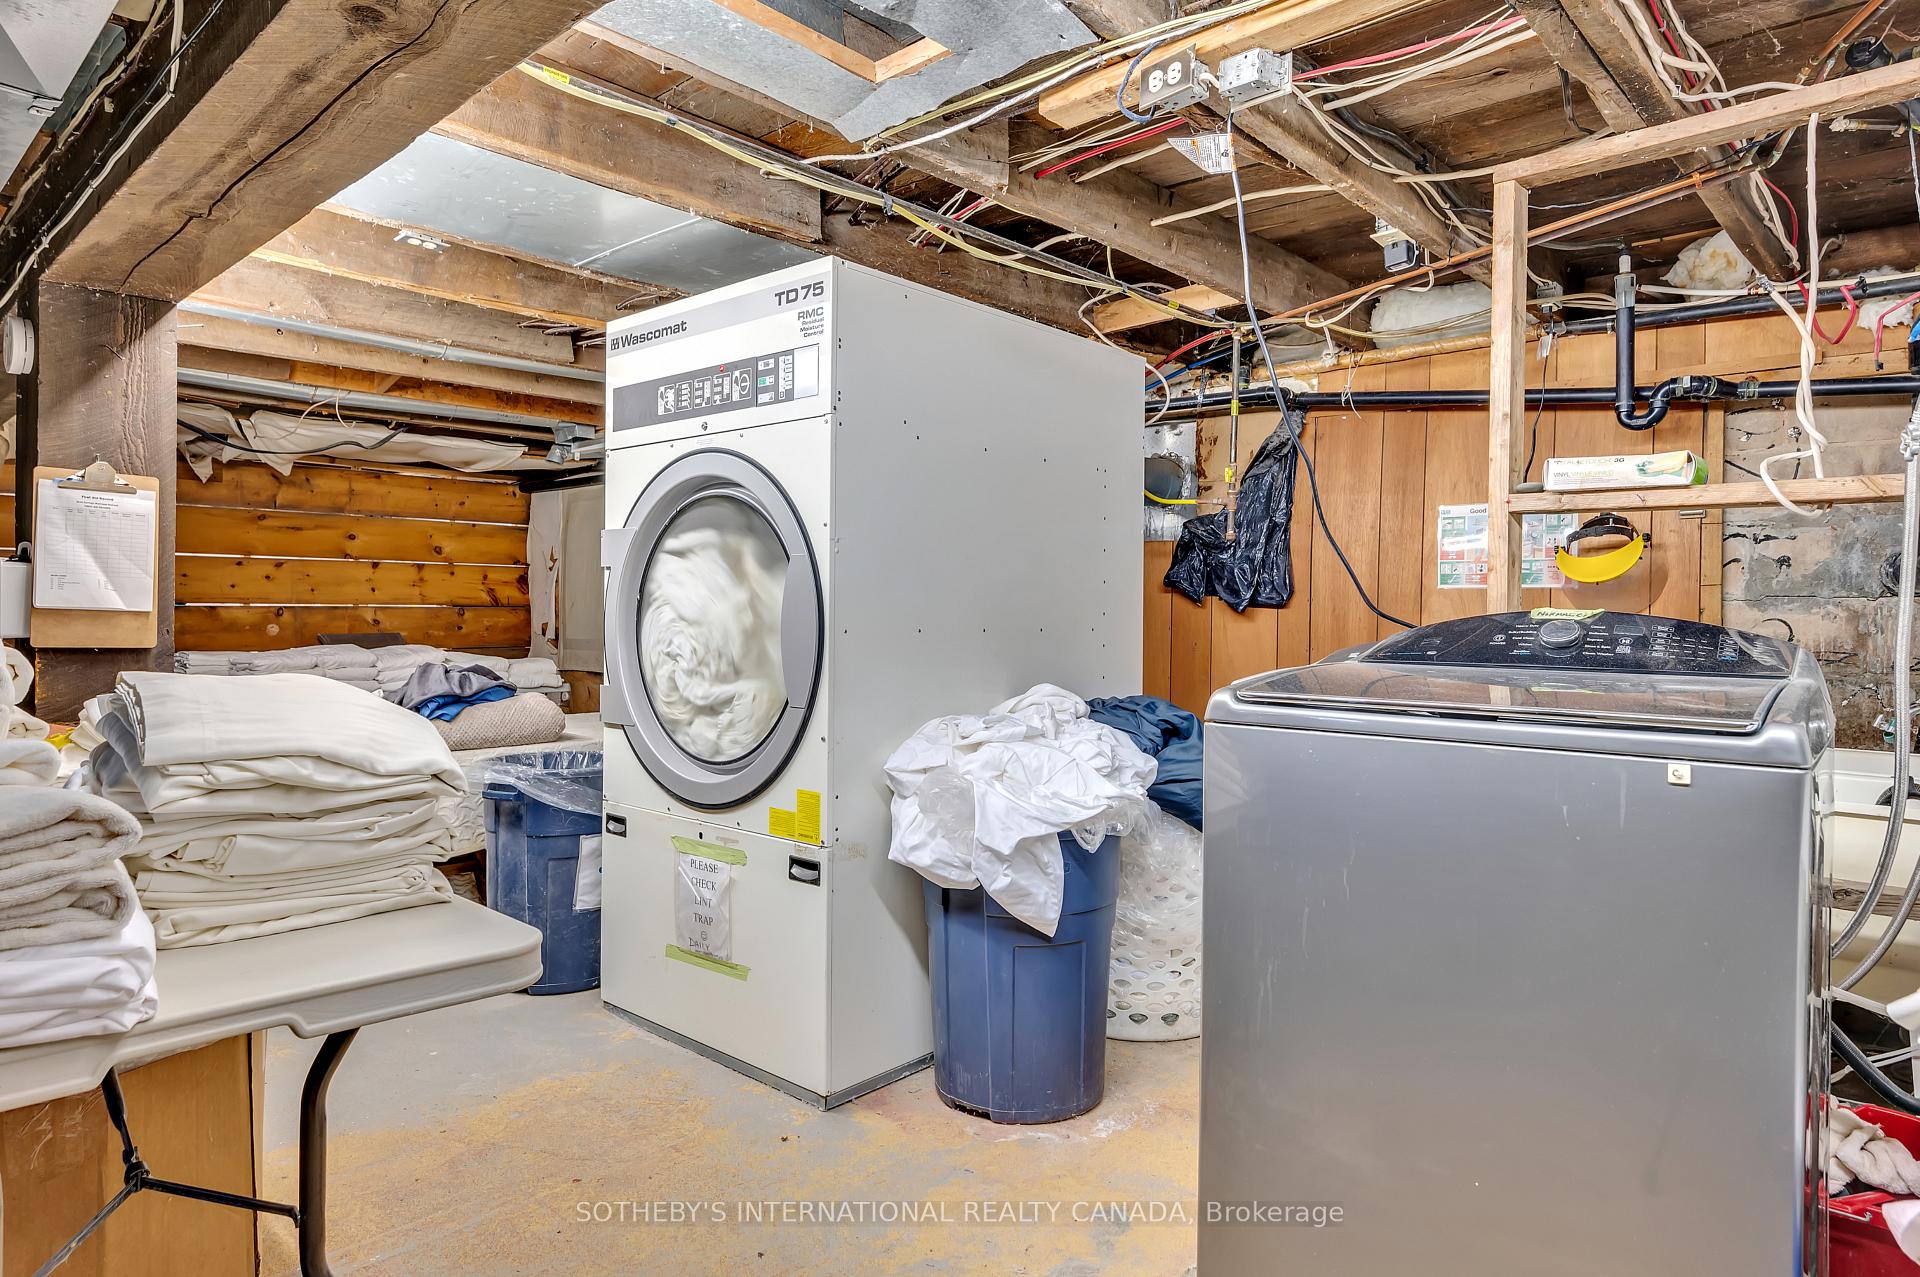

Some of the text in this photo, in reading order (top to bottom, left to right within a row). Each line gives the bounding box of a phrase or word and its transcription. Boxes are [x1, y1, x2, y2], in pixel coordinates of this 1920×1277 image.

[774, 280, 824, 306] TD 75
[798, 306, 824, 320] RMC
[800, 324, 824, 332] Moisture
[802, 317, 824, 326] Residual
[620, 320, 687, 348] Wascomat
[804, 328, 824, 338] Control
[690, 859, 718, 874] PLEASE
[691, 877, 716, 891] CHECK
[694, 896, 712, 908] LINT
[694, 913, 714, 926] TRAP
[688, 936, 710, 951] DAILY
